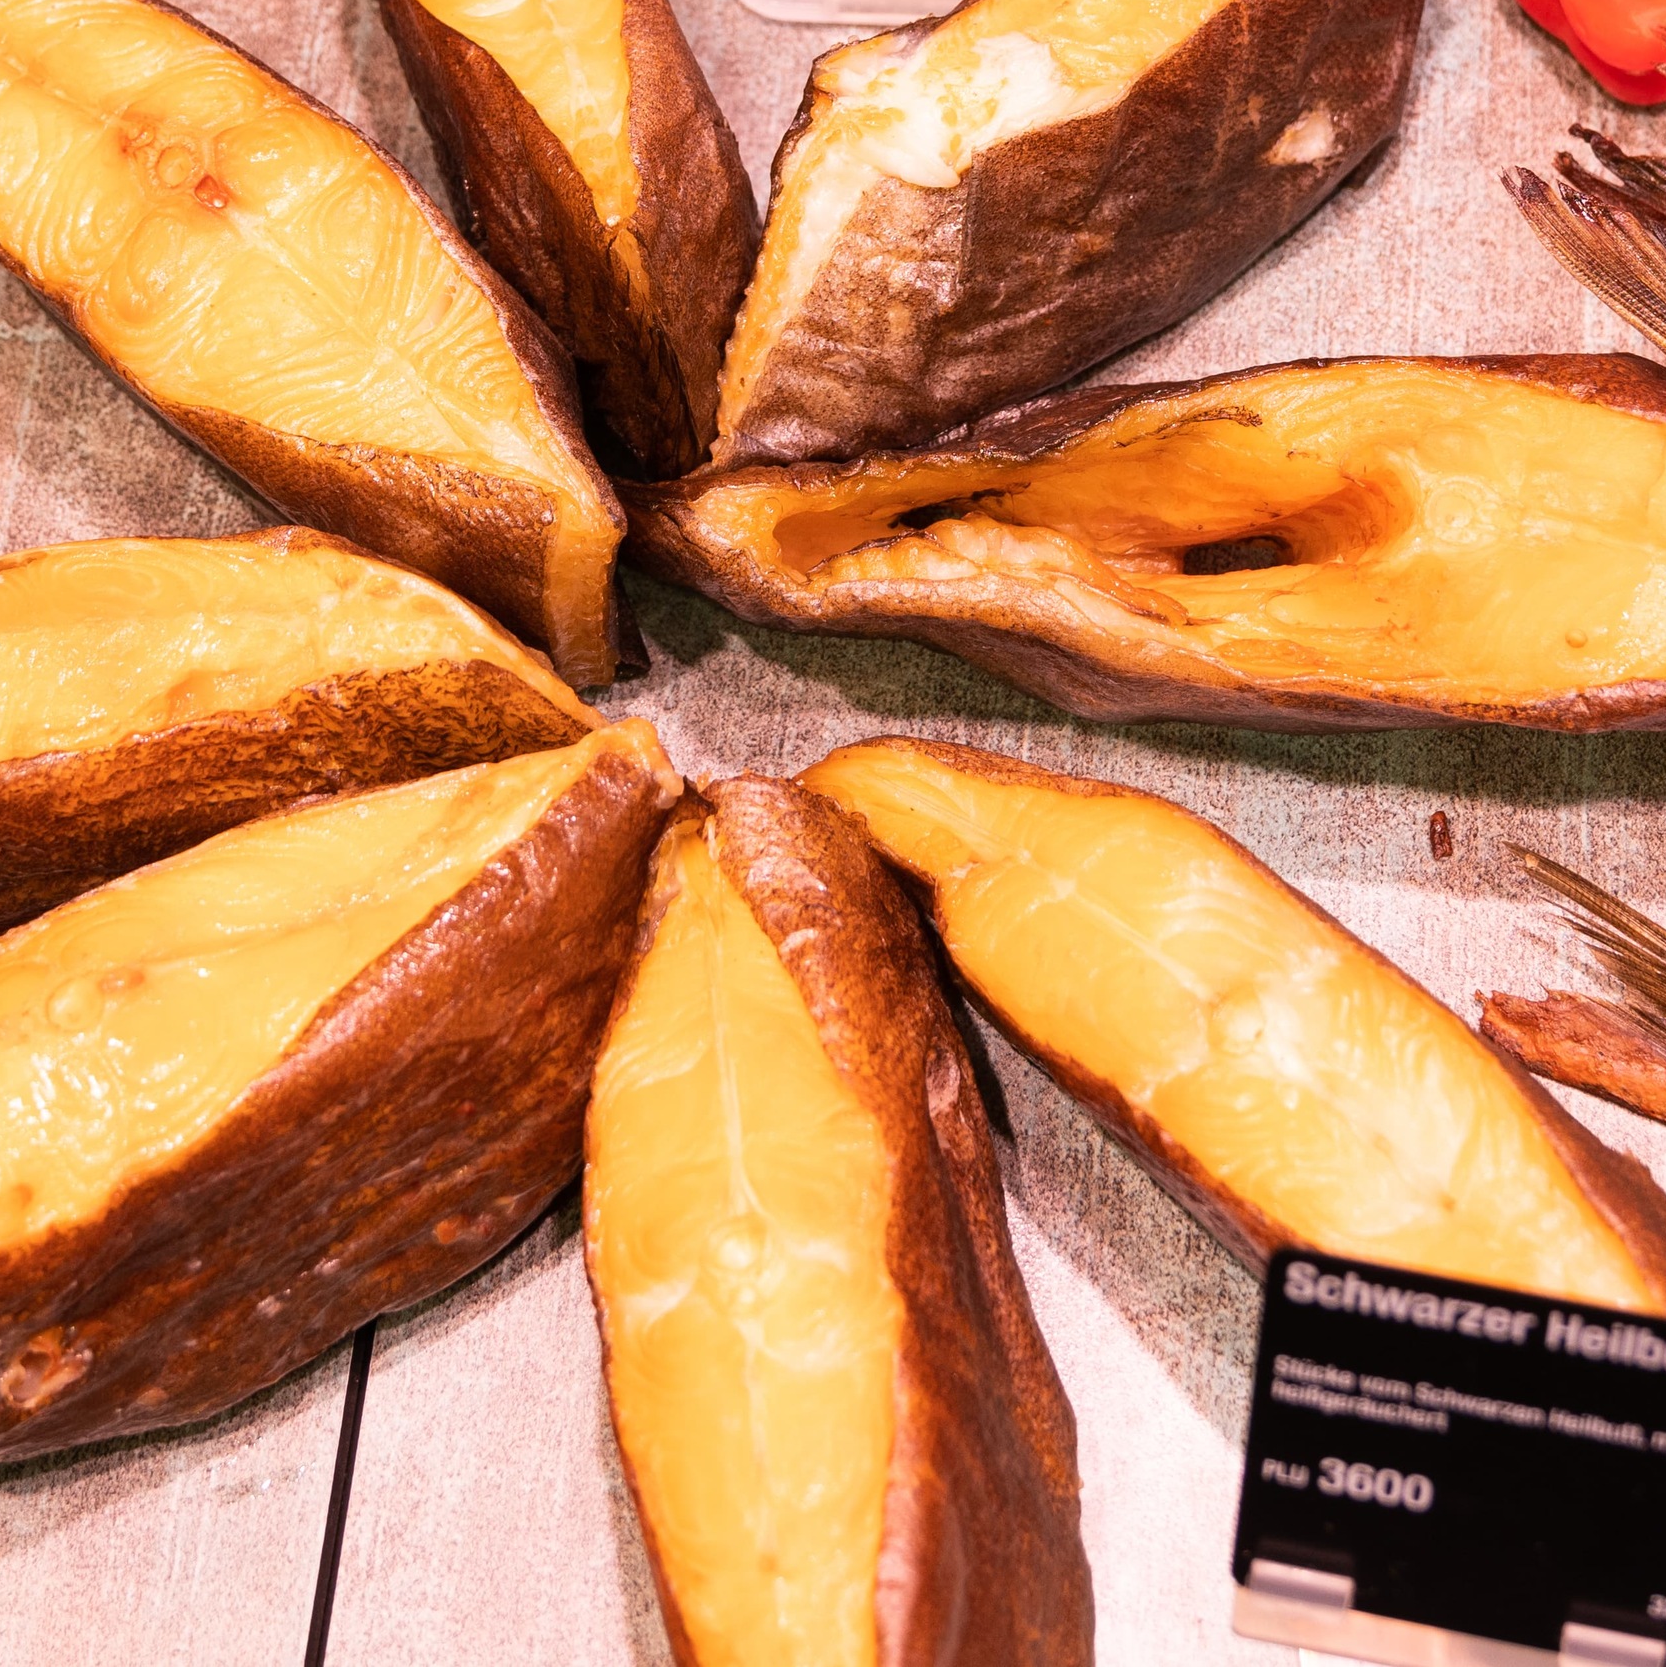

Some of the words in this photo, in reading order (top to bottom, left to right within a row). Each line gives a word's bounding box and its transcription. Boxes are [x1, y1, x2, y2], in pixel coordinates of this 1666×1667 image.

[1283, 1260, 1538, 1346] Schwarzer
[1261, 1457, 1310, 1489] PLU
[1316, 1456, 1434, 1514] 3600
